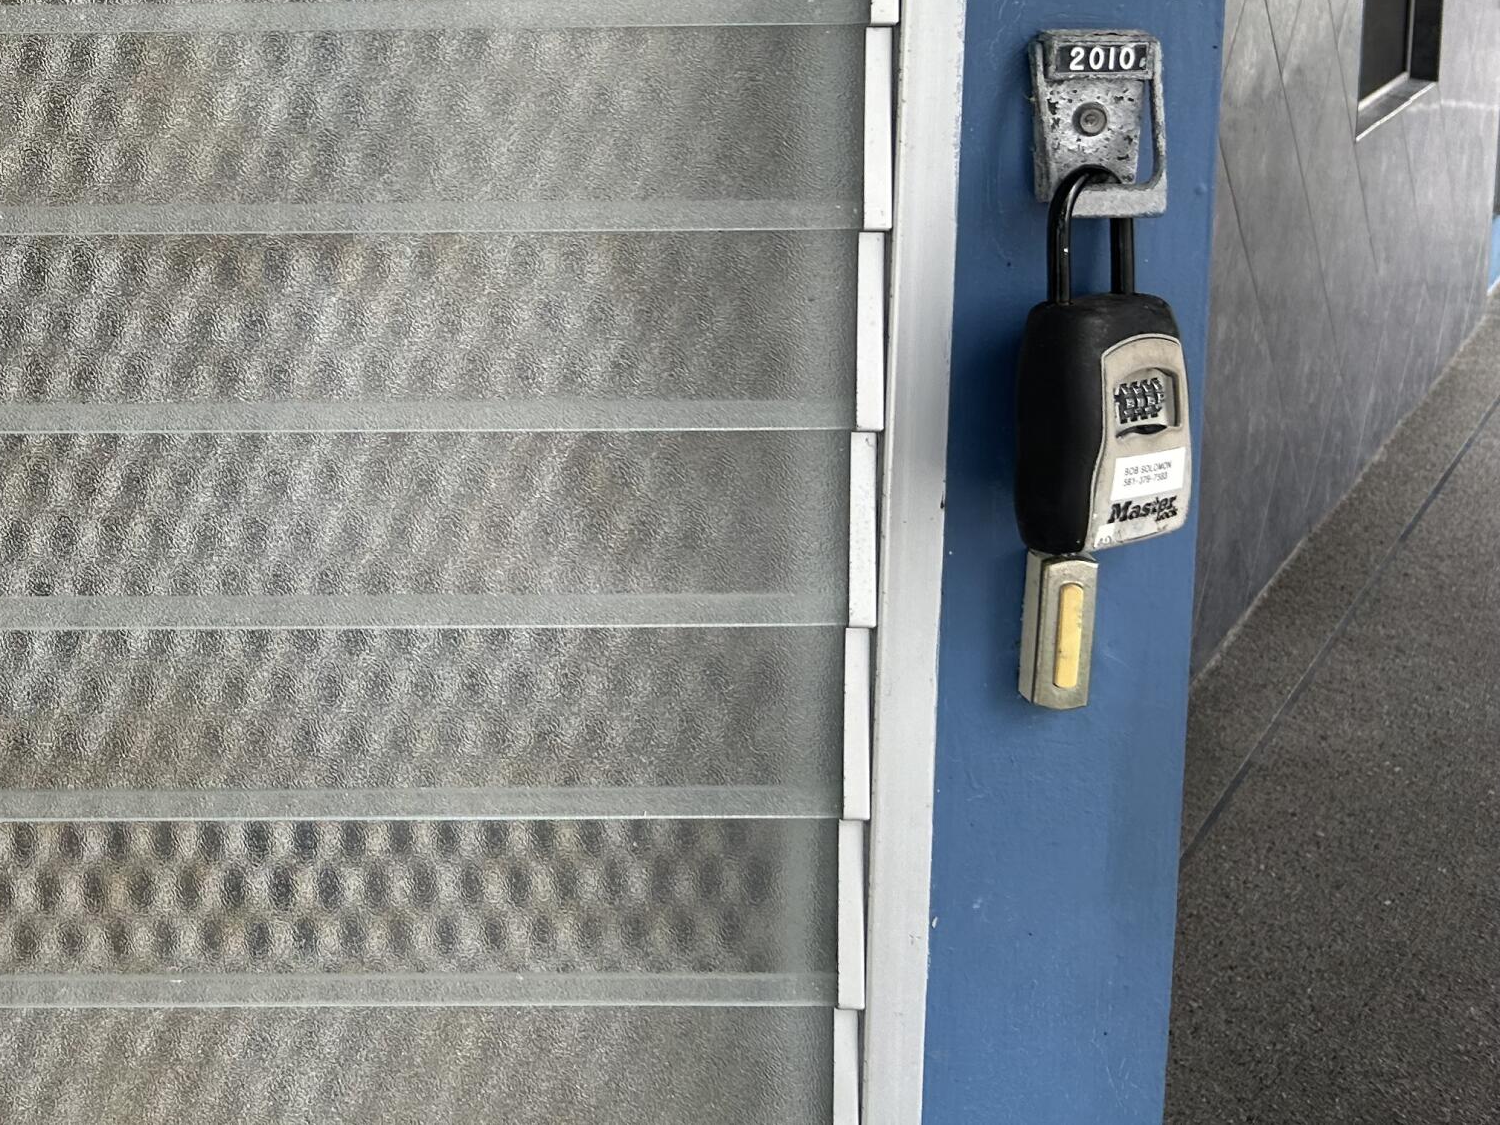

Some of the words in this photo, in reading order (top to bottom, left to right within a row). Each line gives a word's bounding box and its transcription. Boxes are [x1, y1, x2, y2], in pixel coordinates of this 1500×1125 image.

[1069, 46, 1135, 71] 2010
[1124, 465, 1139, 476] BOB
[1141, 460, 1172, 474] SOLOMON
[1107, 495, 1177, 524] Master
